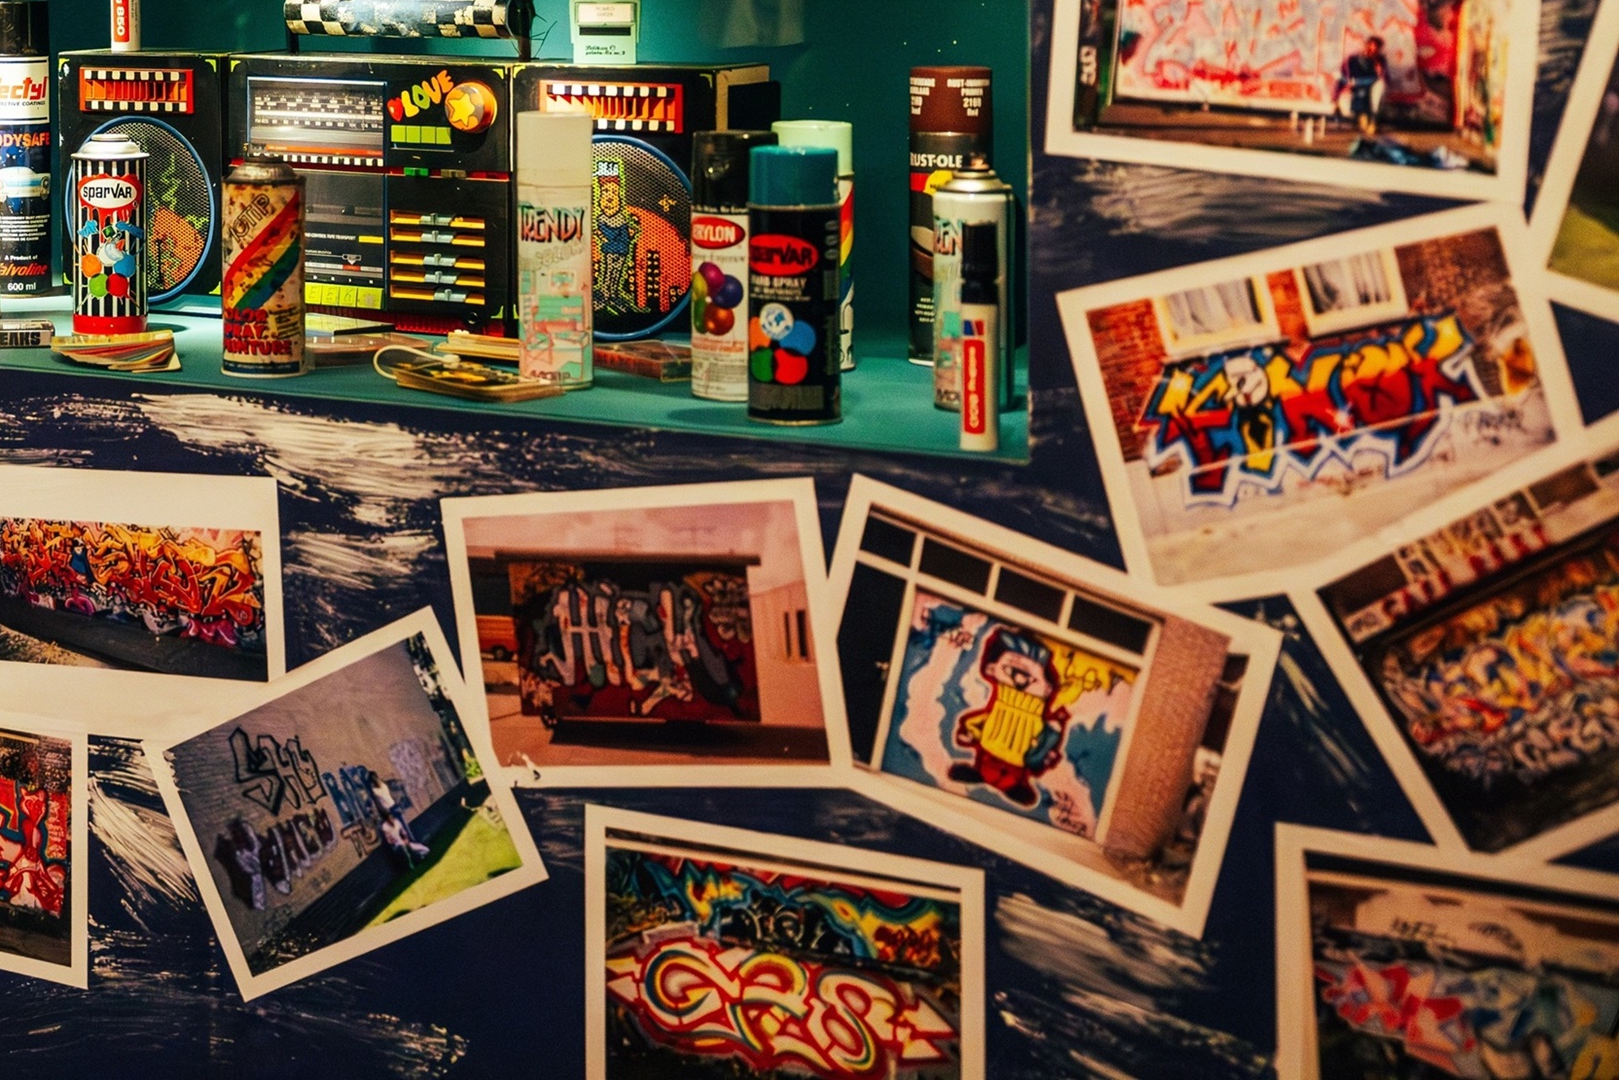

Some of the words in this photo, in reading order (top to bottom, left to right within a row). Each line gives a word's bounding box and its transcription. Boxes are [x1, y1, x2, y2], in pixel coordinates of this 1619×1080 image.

[116, 6, 125, 37] 850
[402, 70, 454, 118] LOVE
[83, 182, 133, 205] sparVAR
[0, 263, 48, 277] alvoline
[7, 282, 24, 291] 600
[25, 282, 37, 290] ml
